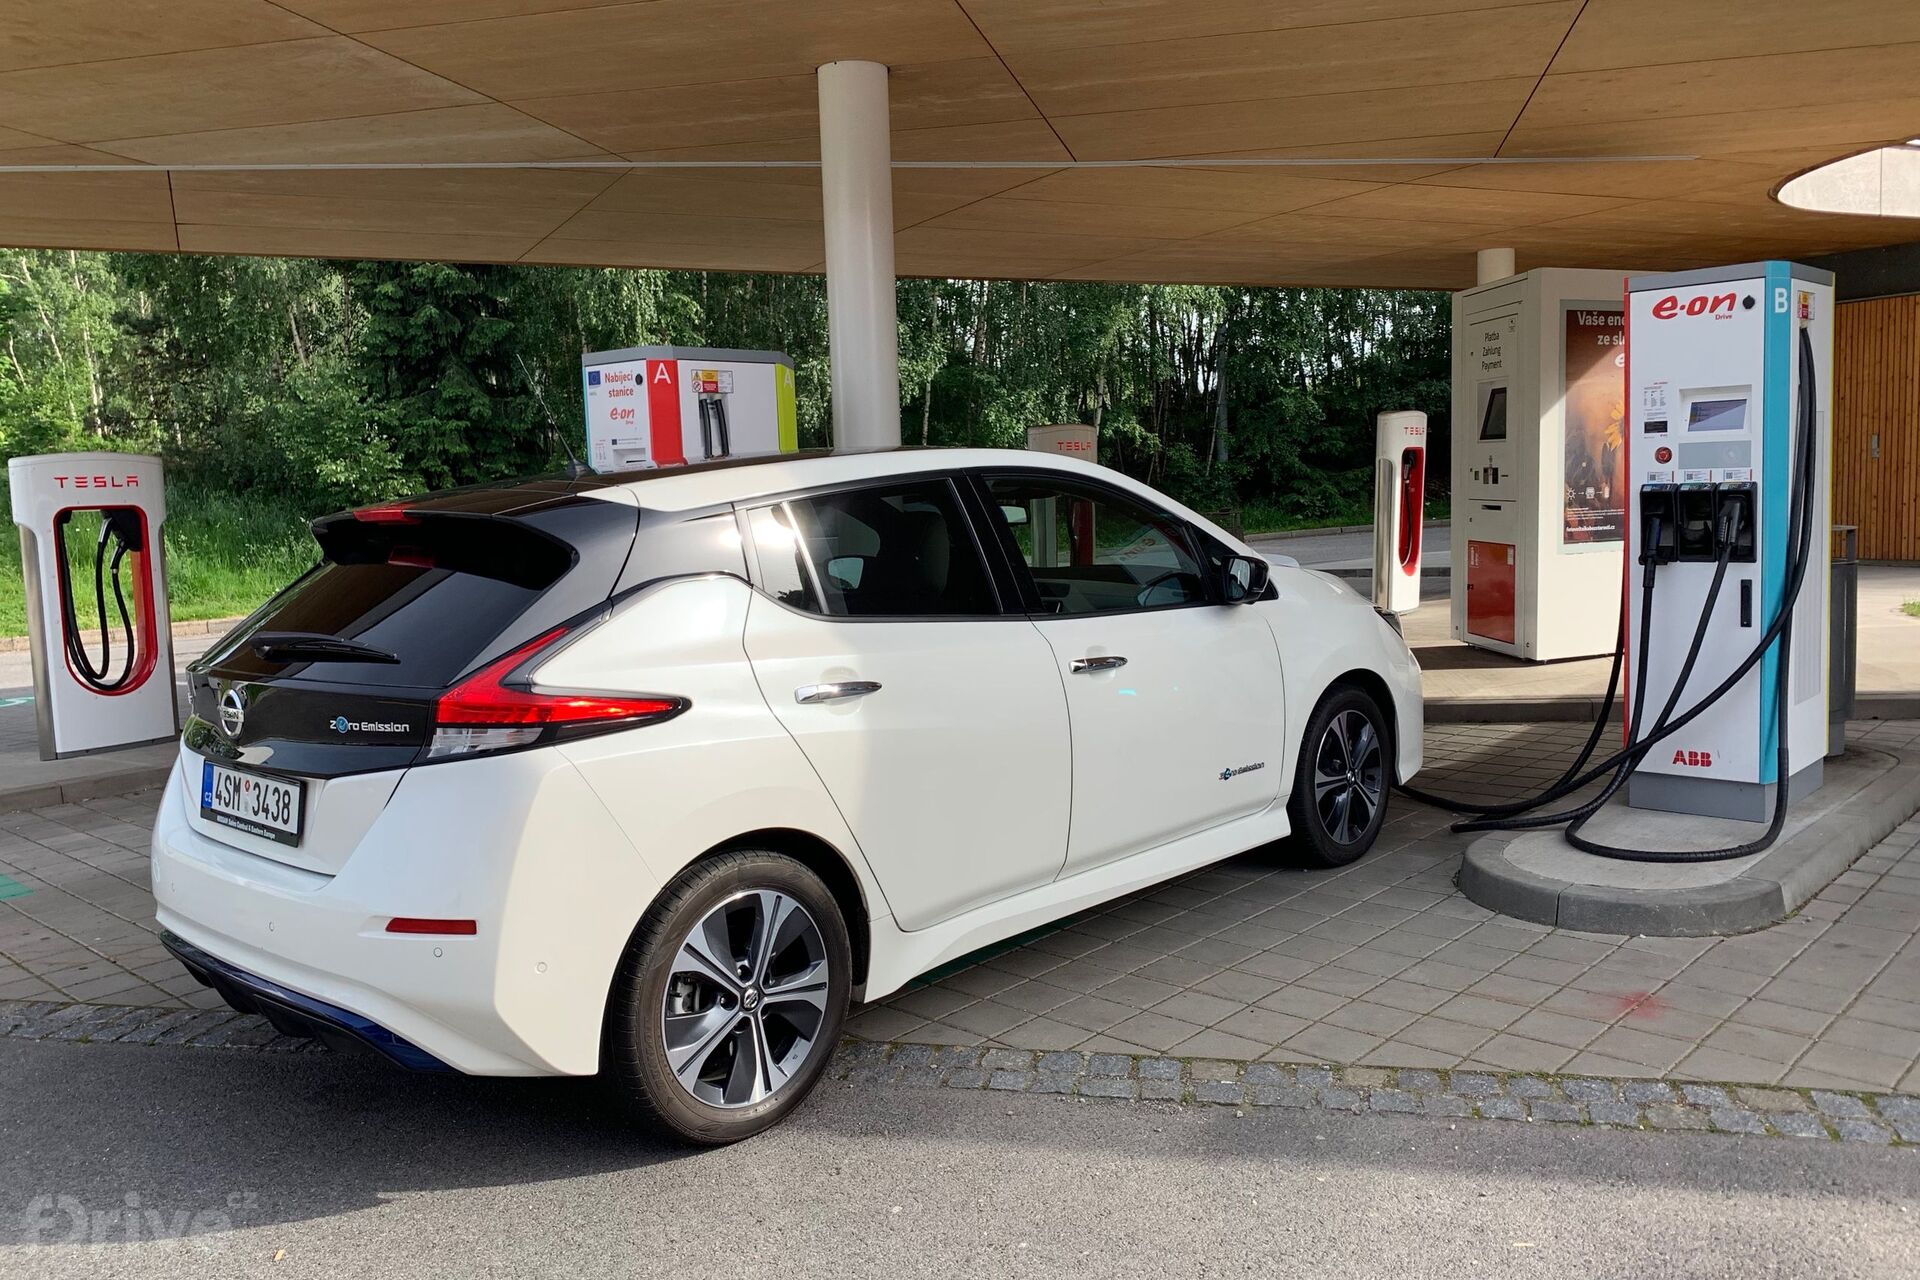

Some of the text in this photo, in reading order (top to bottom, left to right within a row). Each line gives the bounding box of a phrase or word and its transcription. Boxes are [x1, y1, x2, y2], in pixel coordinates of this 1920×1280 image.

[1775, 287, 1788, 313] B
[1577, 311, 1605, 326] Vaše
[1597, 334, 1610, 345] ze
[1481, 359, 1503, 373] Payment
[653, 362, 672, 385] A
[608, 386, 634, 398] stanice
[1057, 440, 1092, 451] TESLA
[53, 475, 139, 489] TESLA
[360, 721, 410, 733] Emission
[1672, 750, 1712, 767] ABB
[204, 791, 212, 803] CZ
[215, 771, 292, 826] 4SM 3438
